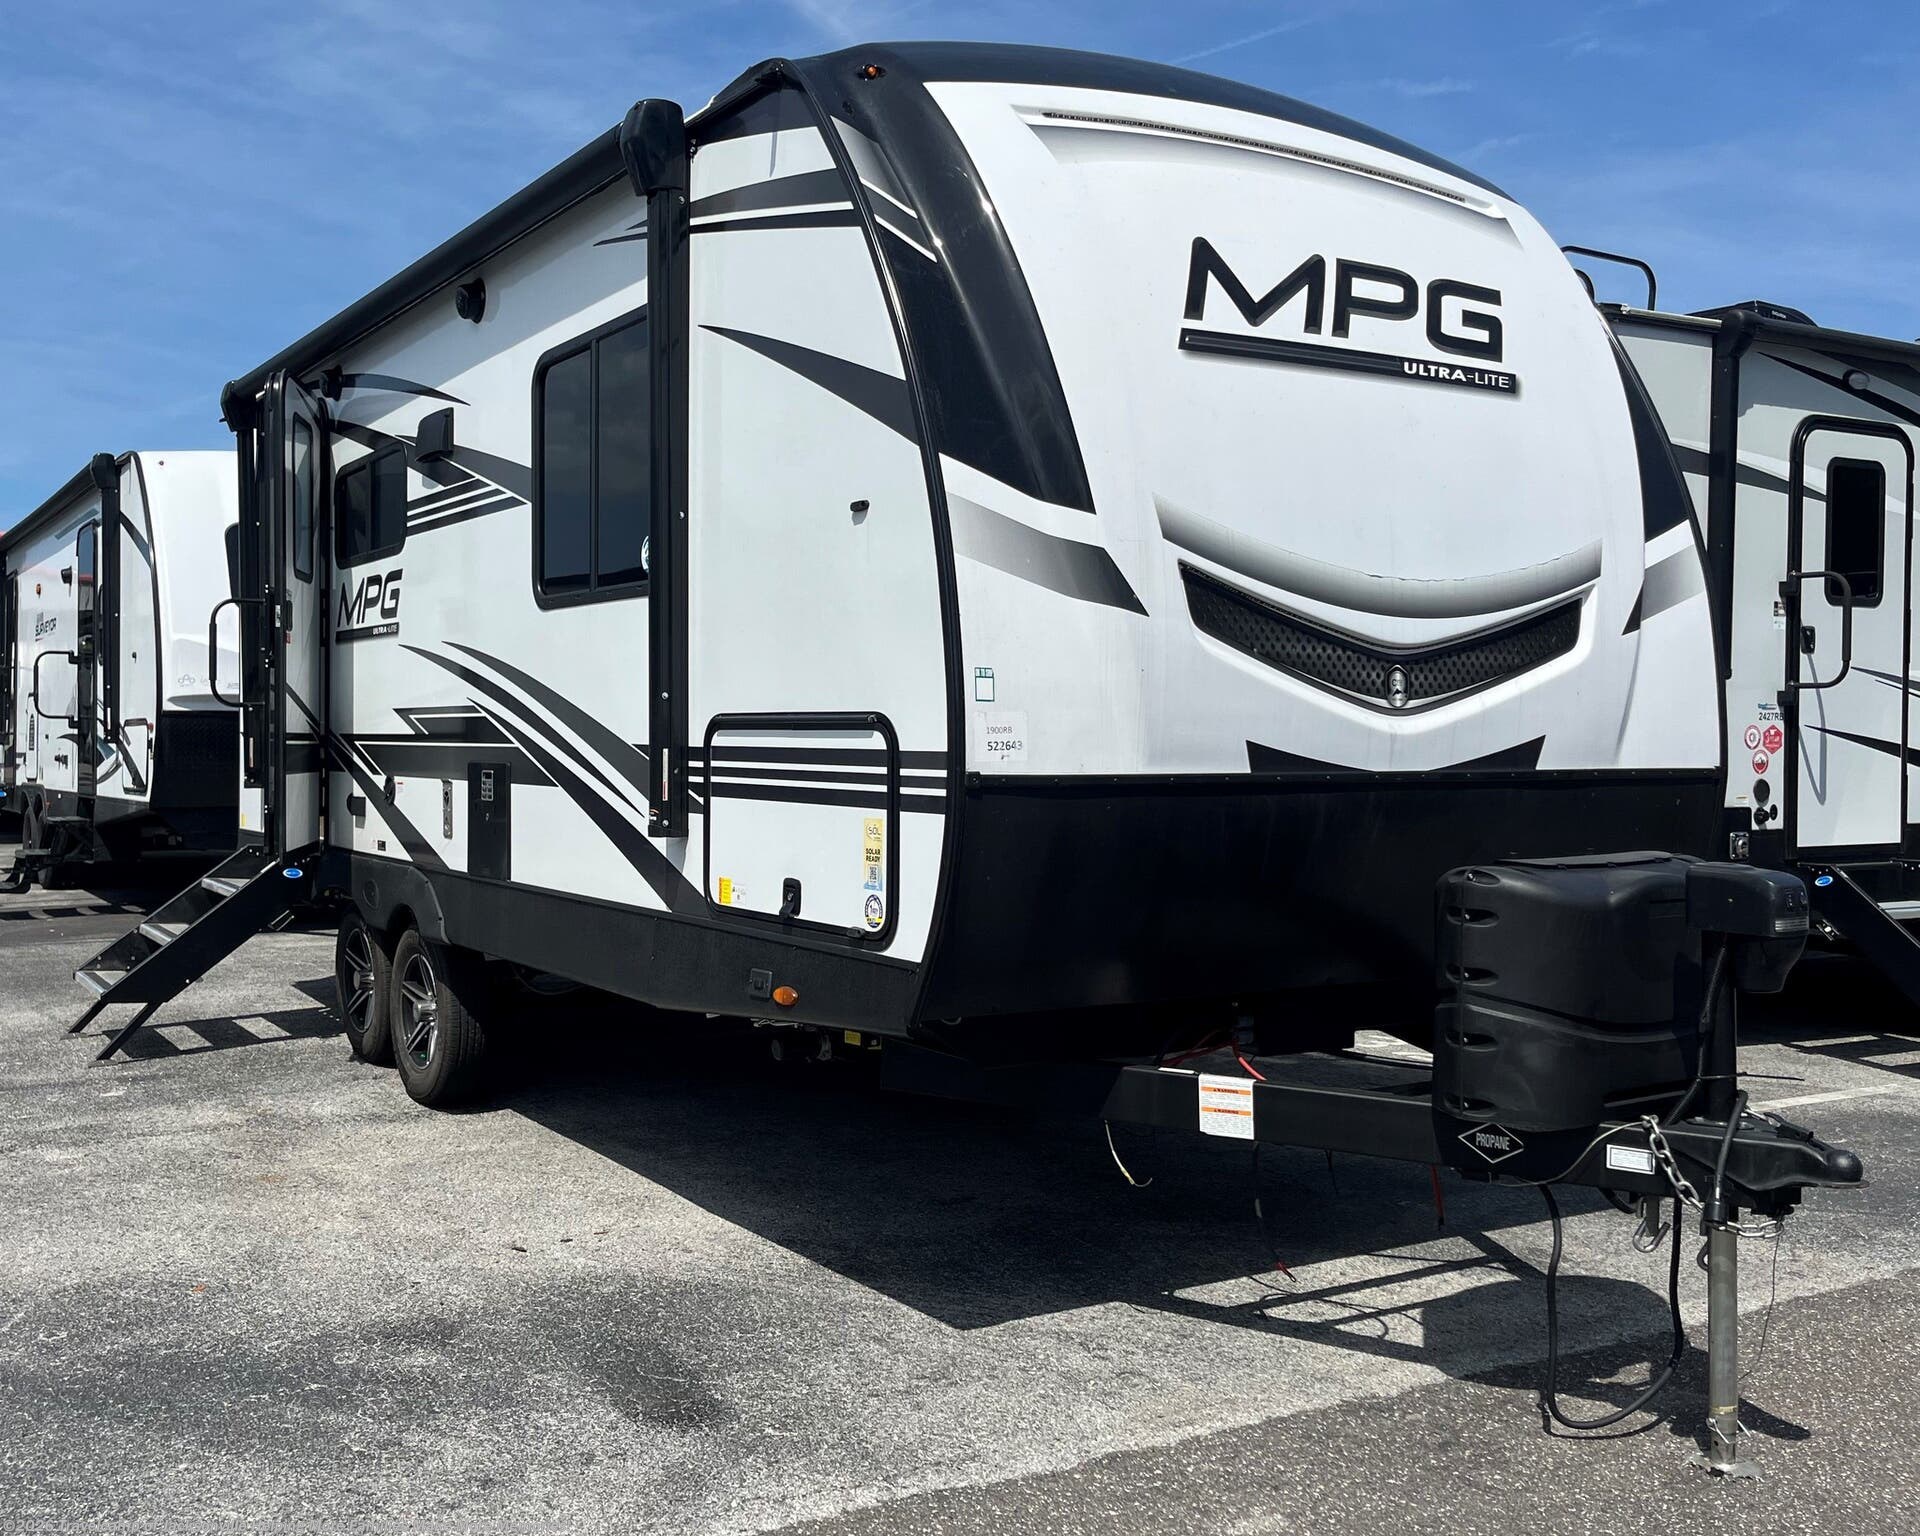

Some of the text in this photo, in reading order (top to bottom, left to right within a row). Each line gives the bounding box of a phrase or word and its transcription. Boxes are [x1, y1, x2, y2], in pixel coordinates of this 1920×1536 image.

[1184, 236, 1503, 363] MPG
[1403, 361, 1510, 388] ULTRA-LITE
[337, 568, 403, 628] MPG
[1758, 712, 1784, 721] 2427RB
[865, 847, 881, 855] SOLAR
[1475, 1132, 1510, 1151] PROPANE
